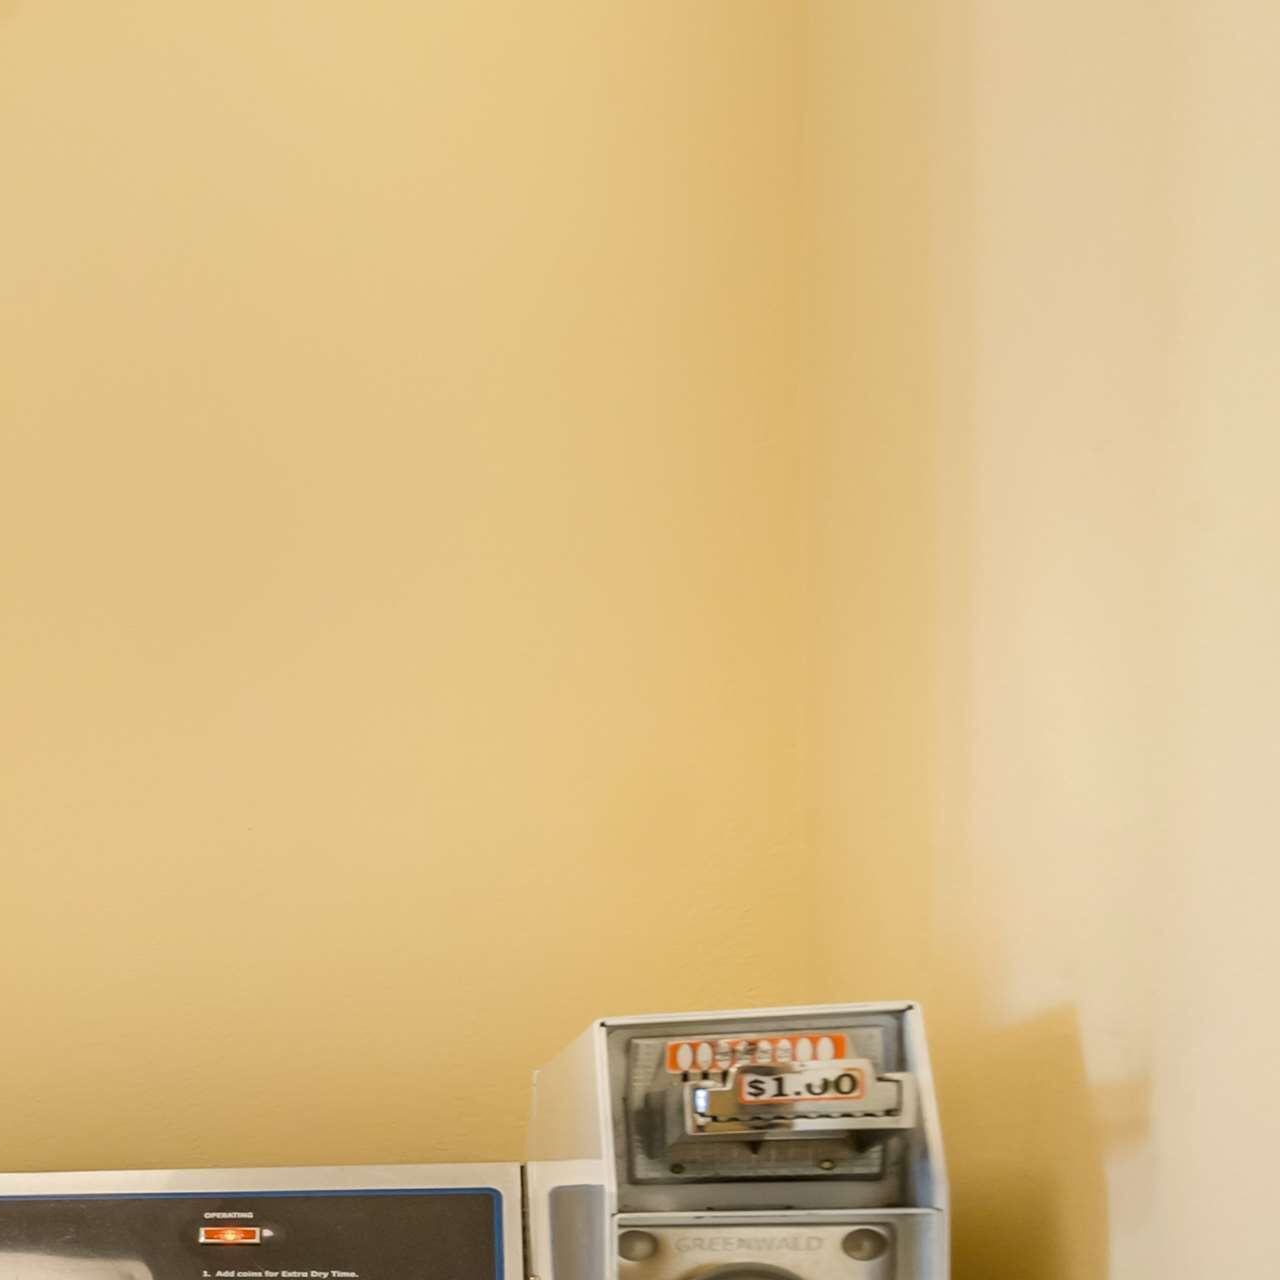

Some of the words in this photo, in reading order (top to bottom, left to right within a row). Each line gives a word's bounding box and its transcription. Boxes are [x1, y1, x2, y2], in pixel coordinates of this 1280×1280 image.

[747, 1073, 858, 1098] $1.00
[203, 1211, 254, 1219] OPERATING
[674, 1235, 824, 1251] GREENWALD
[202, 1270, 212, 1278] 1.
[215, 1270, 236, 1278] Add
[236, 1270, 263, 1278] coins
[264, 1270, 280, 1278] for
[281, 1270, 309, 1278] Extra
[310, 1270, 330, 1279] Dry
[330, 1270, 359, 1278] Time.
